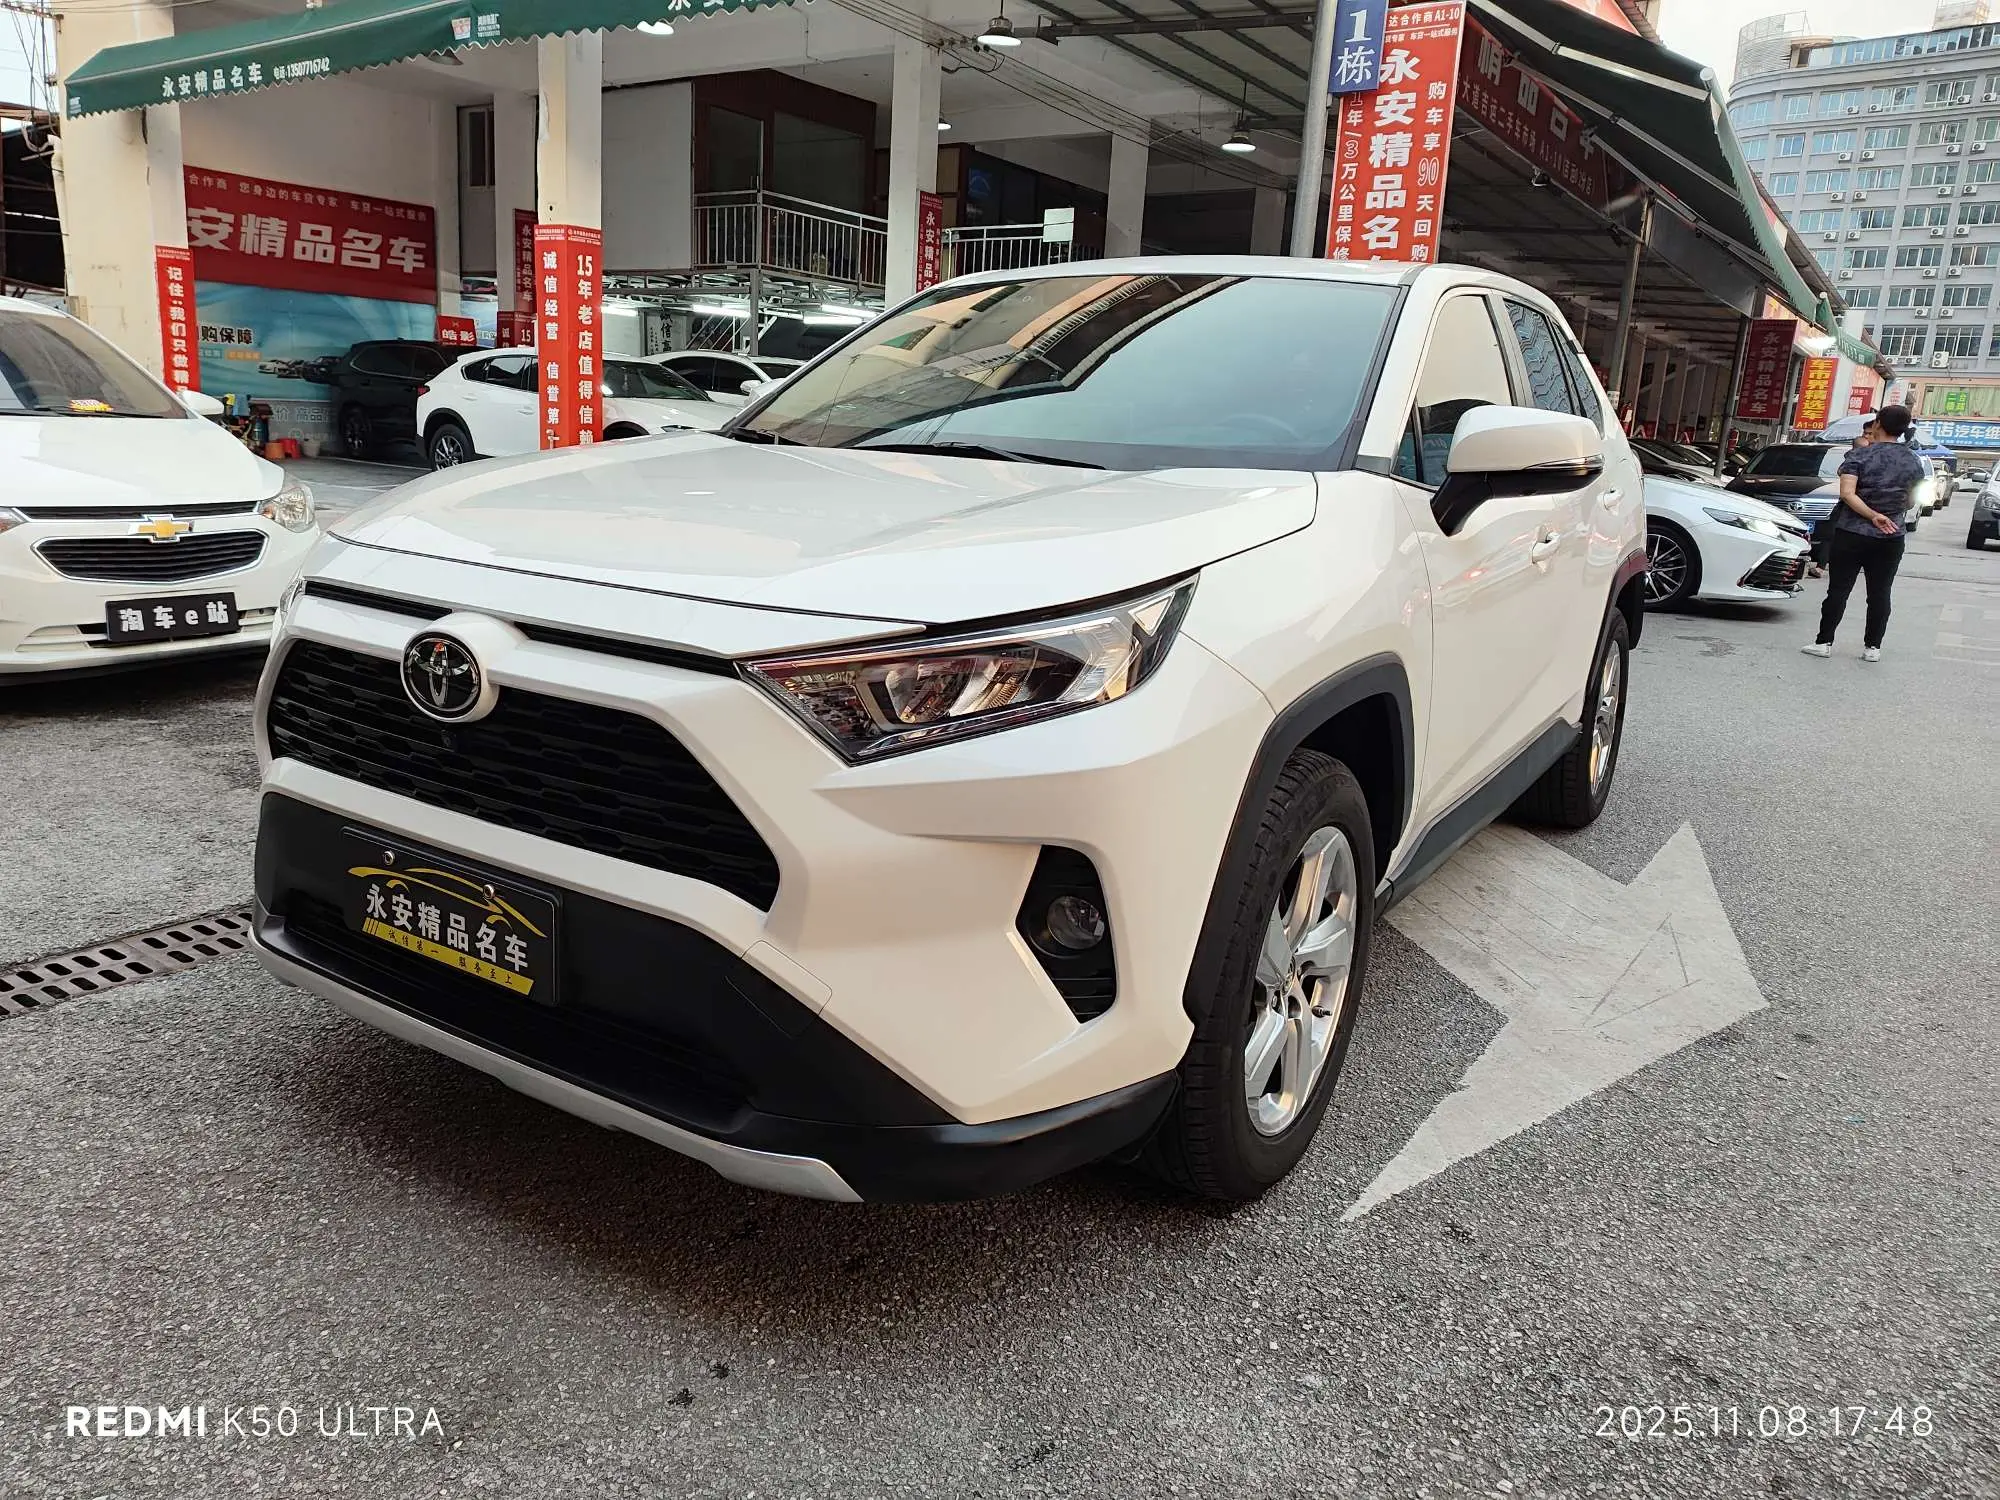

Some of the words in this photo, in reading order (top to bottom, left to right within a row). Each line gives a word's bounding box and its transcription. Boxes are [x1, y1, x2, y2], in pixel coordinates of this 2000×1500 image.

[162, 63, 263, 98] 永安精品名车
[1335, 9, 1376, 86] 1栋
[1360, 48, 1421, 262] 永安精品名
[1410, 80, 1447, 262] 购车享90天回购
[187, 206, 427, 274] 安精品名车
[542, 250, 559, 342] 诚信经营
[197, 325, 254, 346] 购保障
[577, 254, 594, 445] 15年老店值得信赖
[1796, 421, 1824, 429] A1-08
[119, 600, 230, 632] 淘车e站
[365, 883, 529, 972] 永安精品名车
[388, 929, 440, 954] 诚信第一
[458, 956, 513, 984] 服务至上
